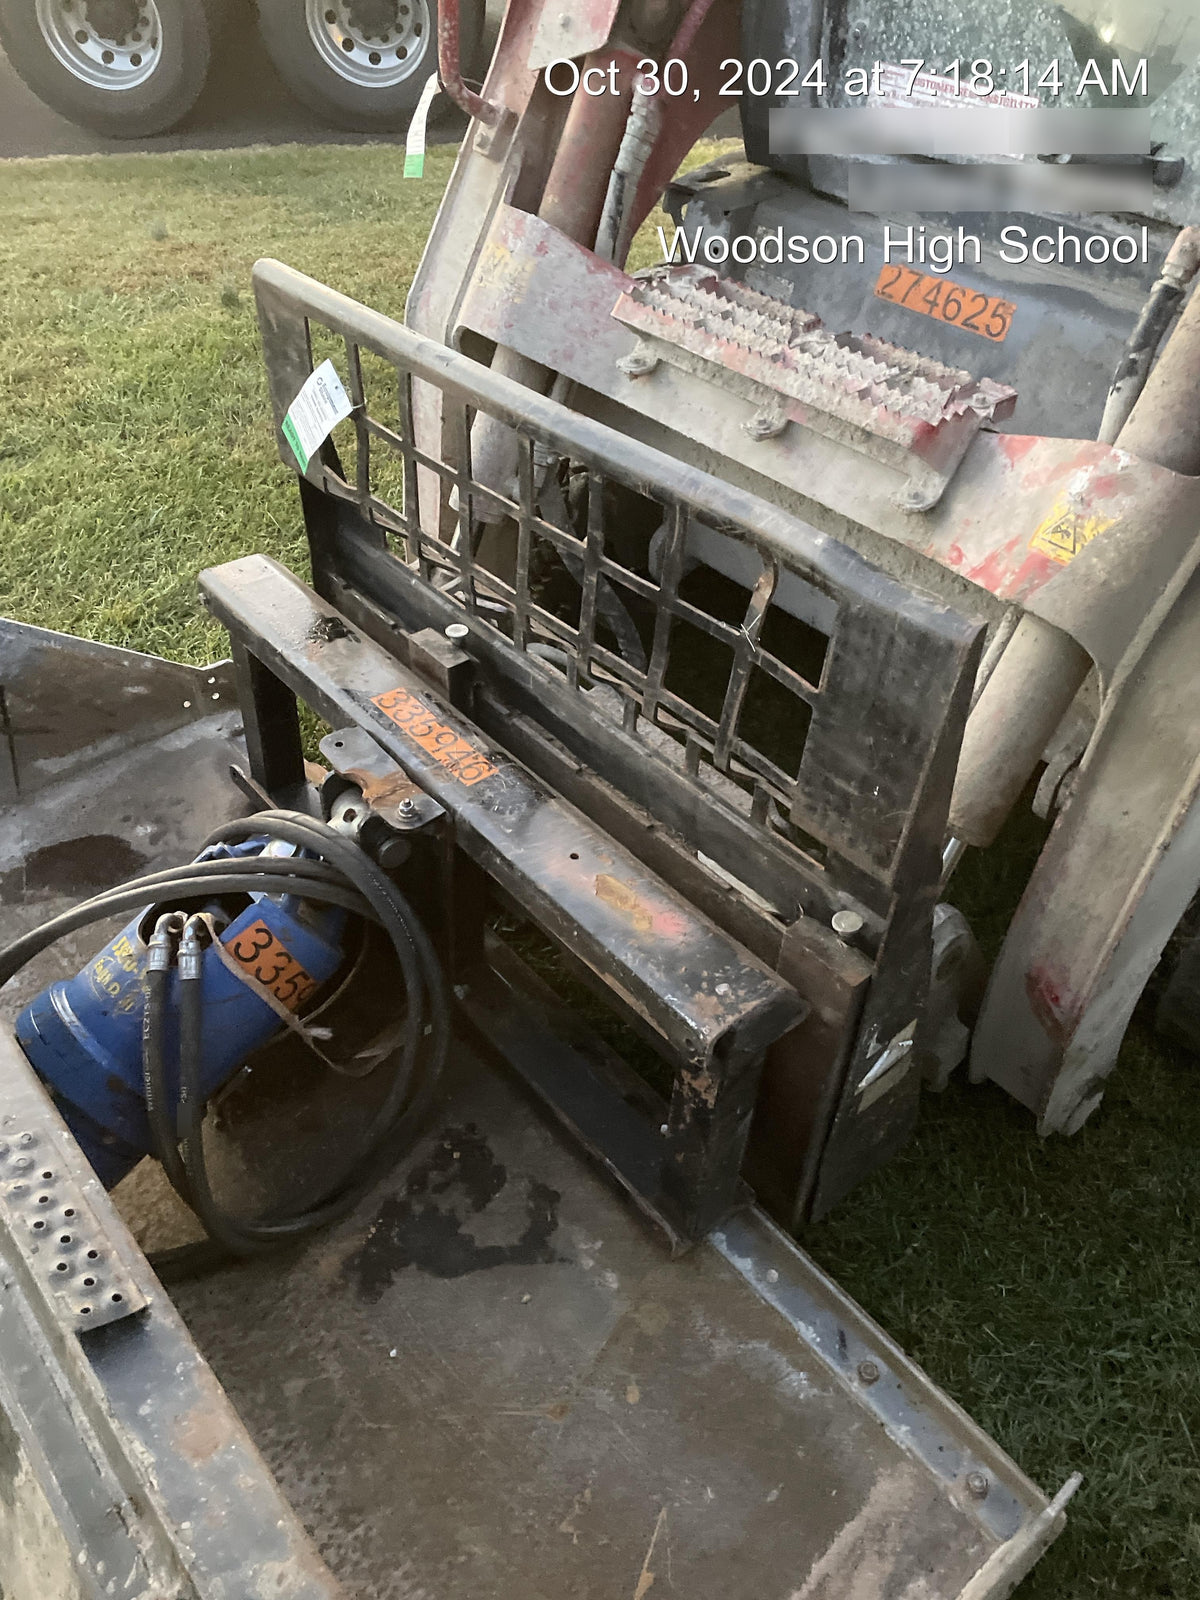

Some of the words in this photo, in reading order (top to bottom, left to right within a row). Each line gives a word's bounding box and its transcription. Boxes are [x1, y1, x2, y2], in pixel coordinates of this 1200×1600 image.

[909, 77, 955, 94] USTOMER
[877, 267, 1007, 338] 274625
[378, 690, 494, 781] 335946
